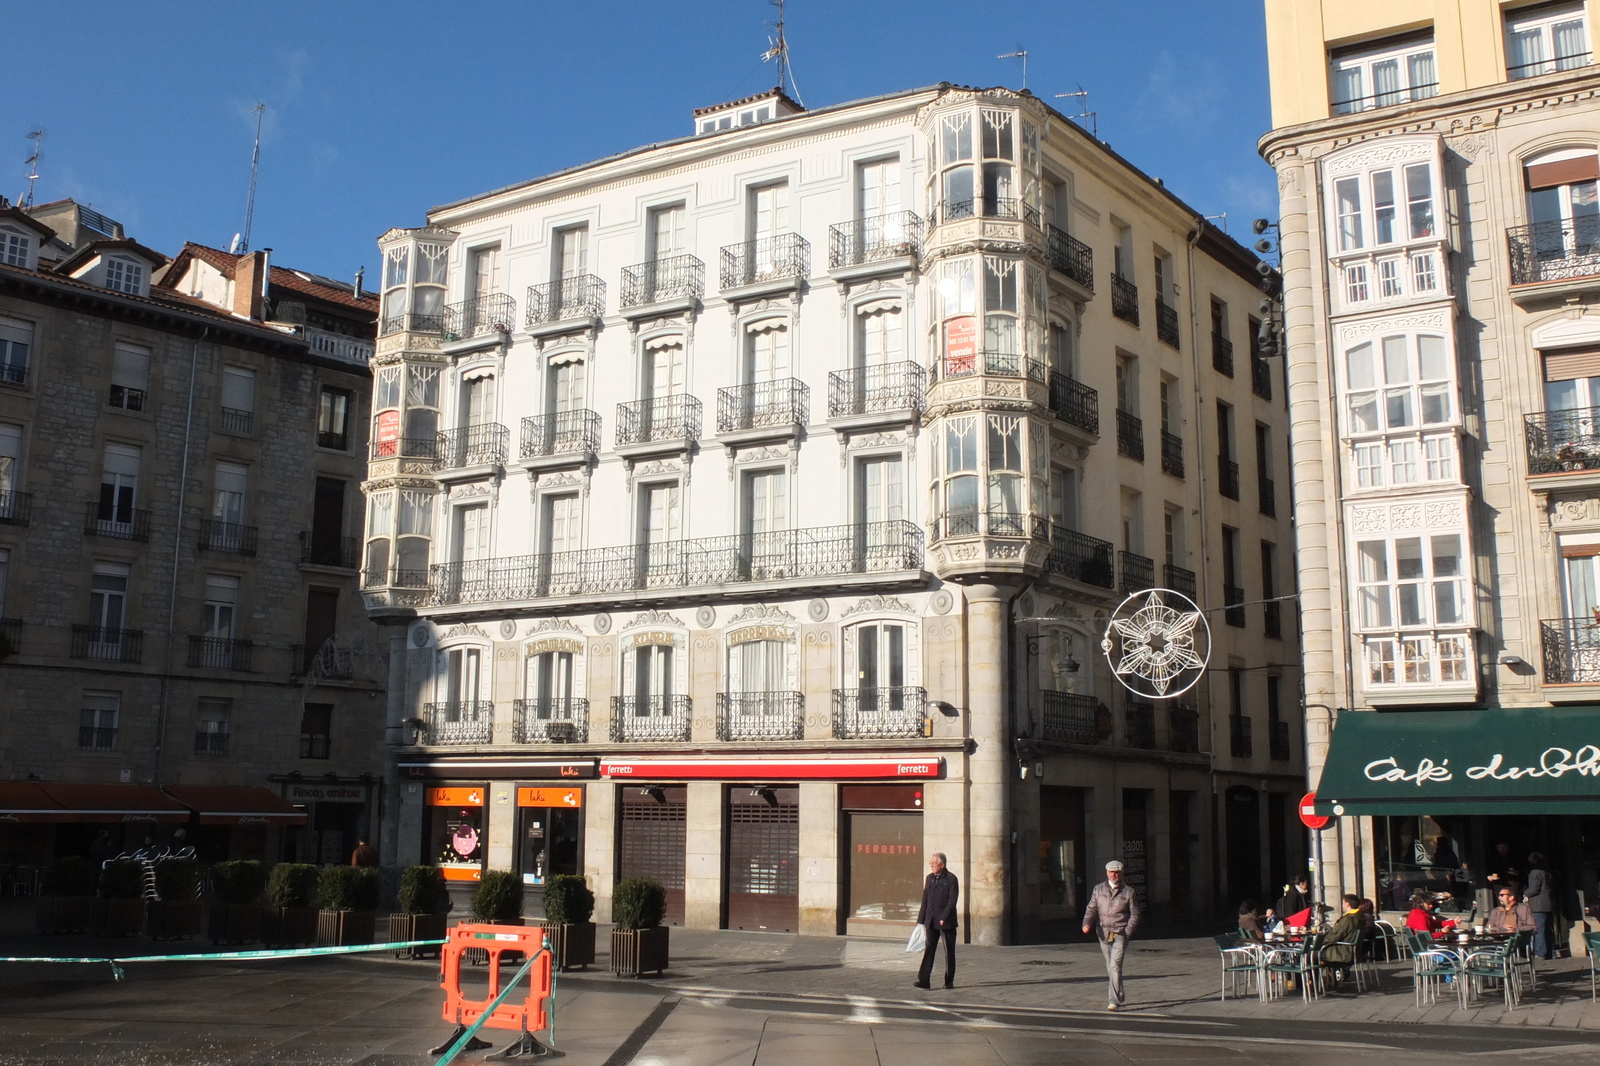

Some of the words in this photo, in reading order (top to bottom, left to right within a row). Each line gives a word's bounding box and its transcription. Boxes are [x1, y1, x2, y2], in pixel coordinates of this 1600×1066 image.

[950, 346, 973, 357] vende
[607, 764, 633, 775] ferretti
[897, 764, 929, 775] ferretti
[1364, 756, 1453, 786] Café
[326, 788, 361, 798] anitua
[857, 844, 917, 854] FERRETTI
